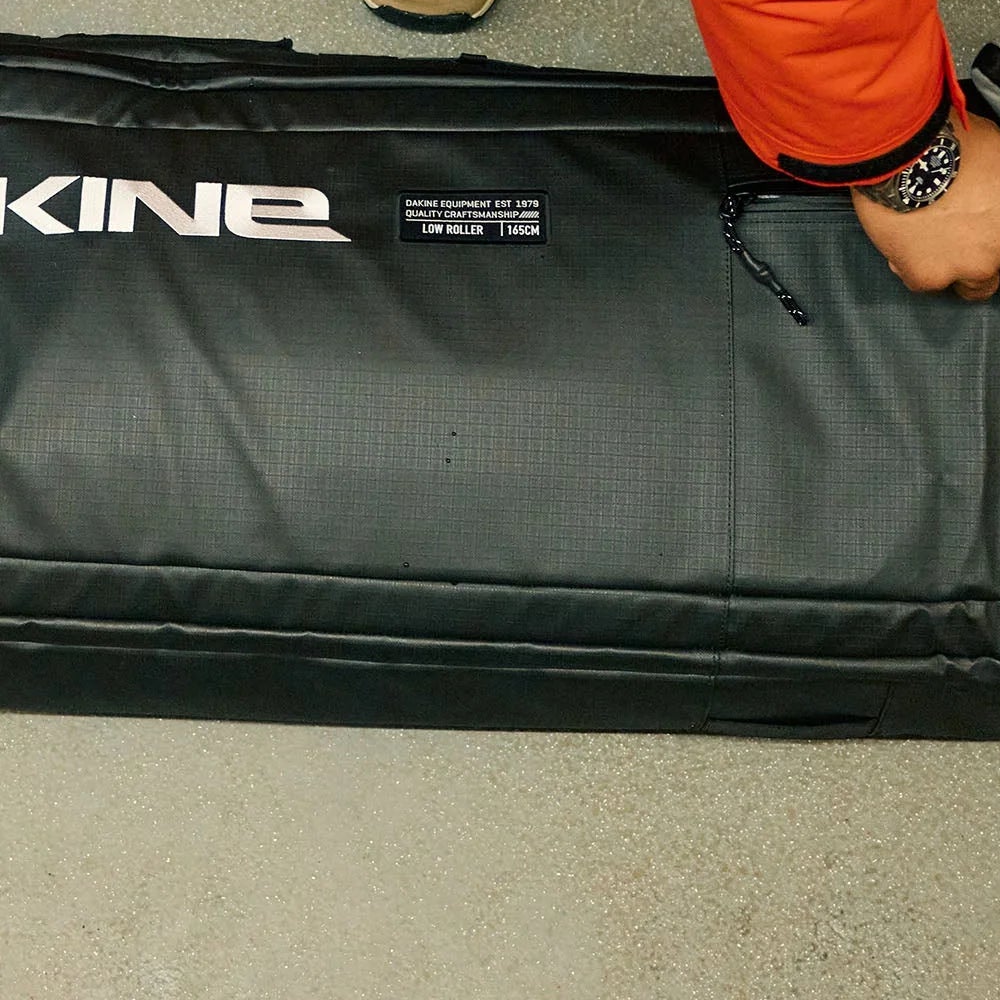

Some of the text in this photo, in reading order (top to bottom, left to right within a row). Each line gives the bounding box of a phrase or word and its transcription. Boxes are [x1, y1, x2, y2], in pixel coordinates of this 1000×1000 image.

[405, 199, 540, 209] DAKINE EQUIPMENT EST 1979
[405, 209, 520, 219] QUALITY CRAFTSMANSHIP
[422, 223, 540, 236] LOW ROLLER 165CM
